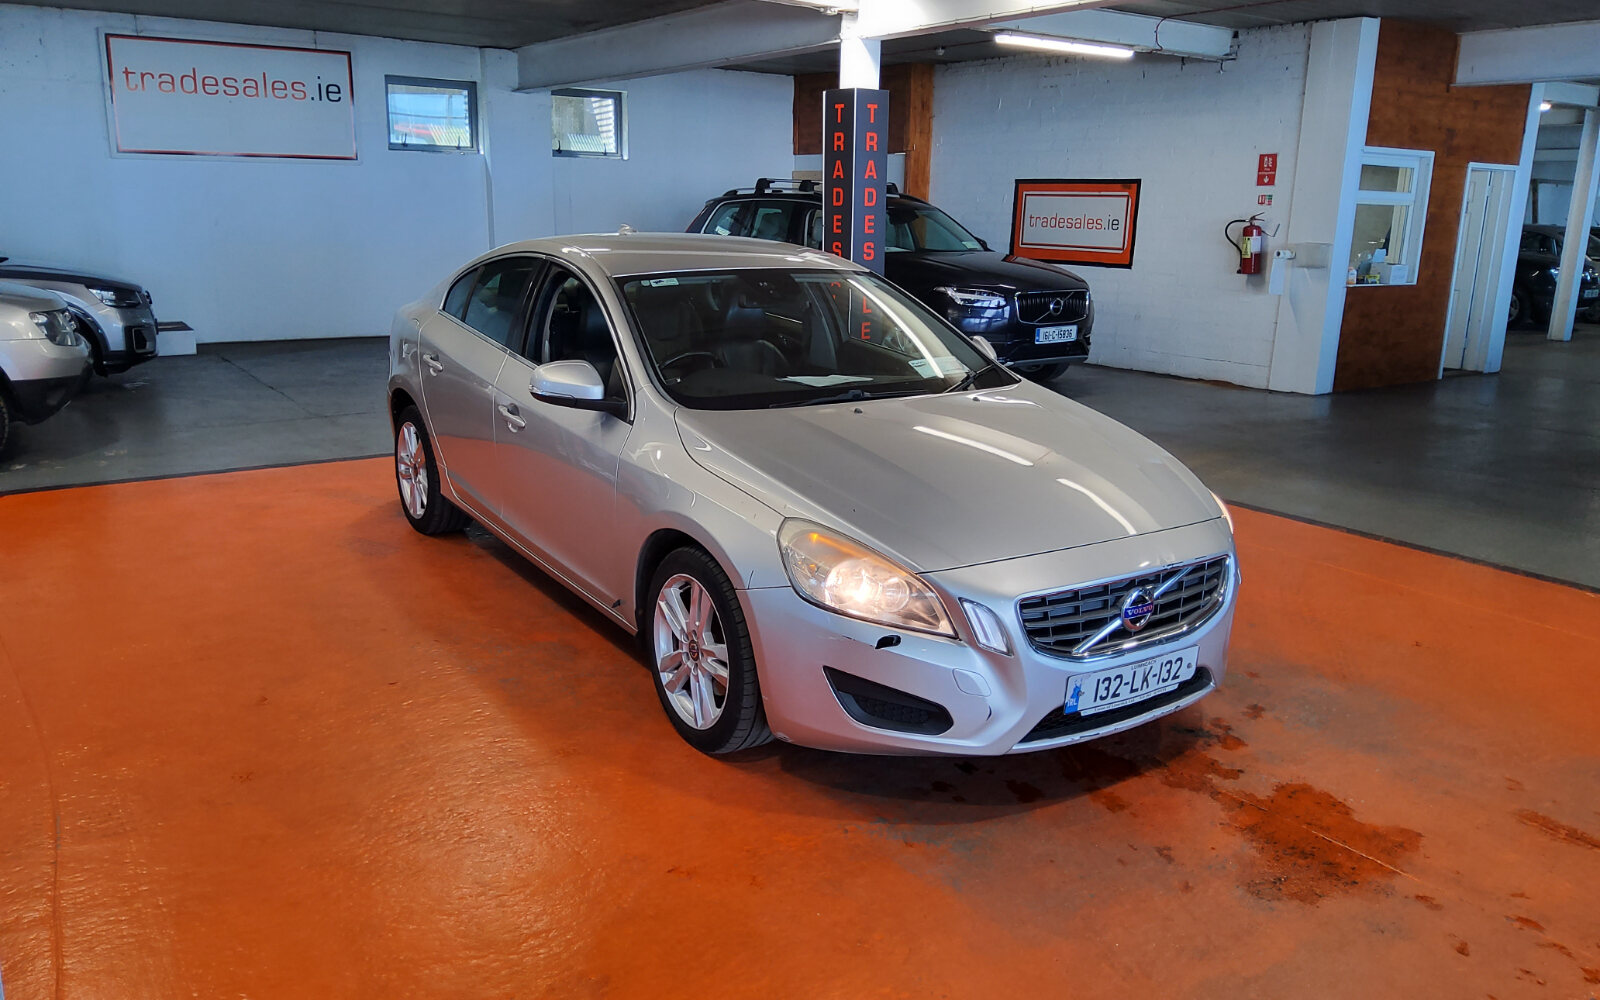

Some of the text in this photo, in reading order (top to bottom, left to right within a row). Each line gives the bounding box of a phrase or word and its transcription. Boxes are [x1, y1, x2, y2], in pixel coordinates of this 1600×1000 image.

[122, 66, 342, 103] tradesales.ie
[1029, 212, 1120, 231] tradesales.ie
[1127, 603, 1153, 616] VOLVO
[1093, 656, 1183, 703] 132-LK-132
